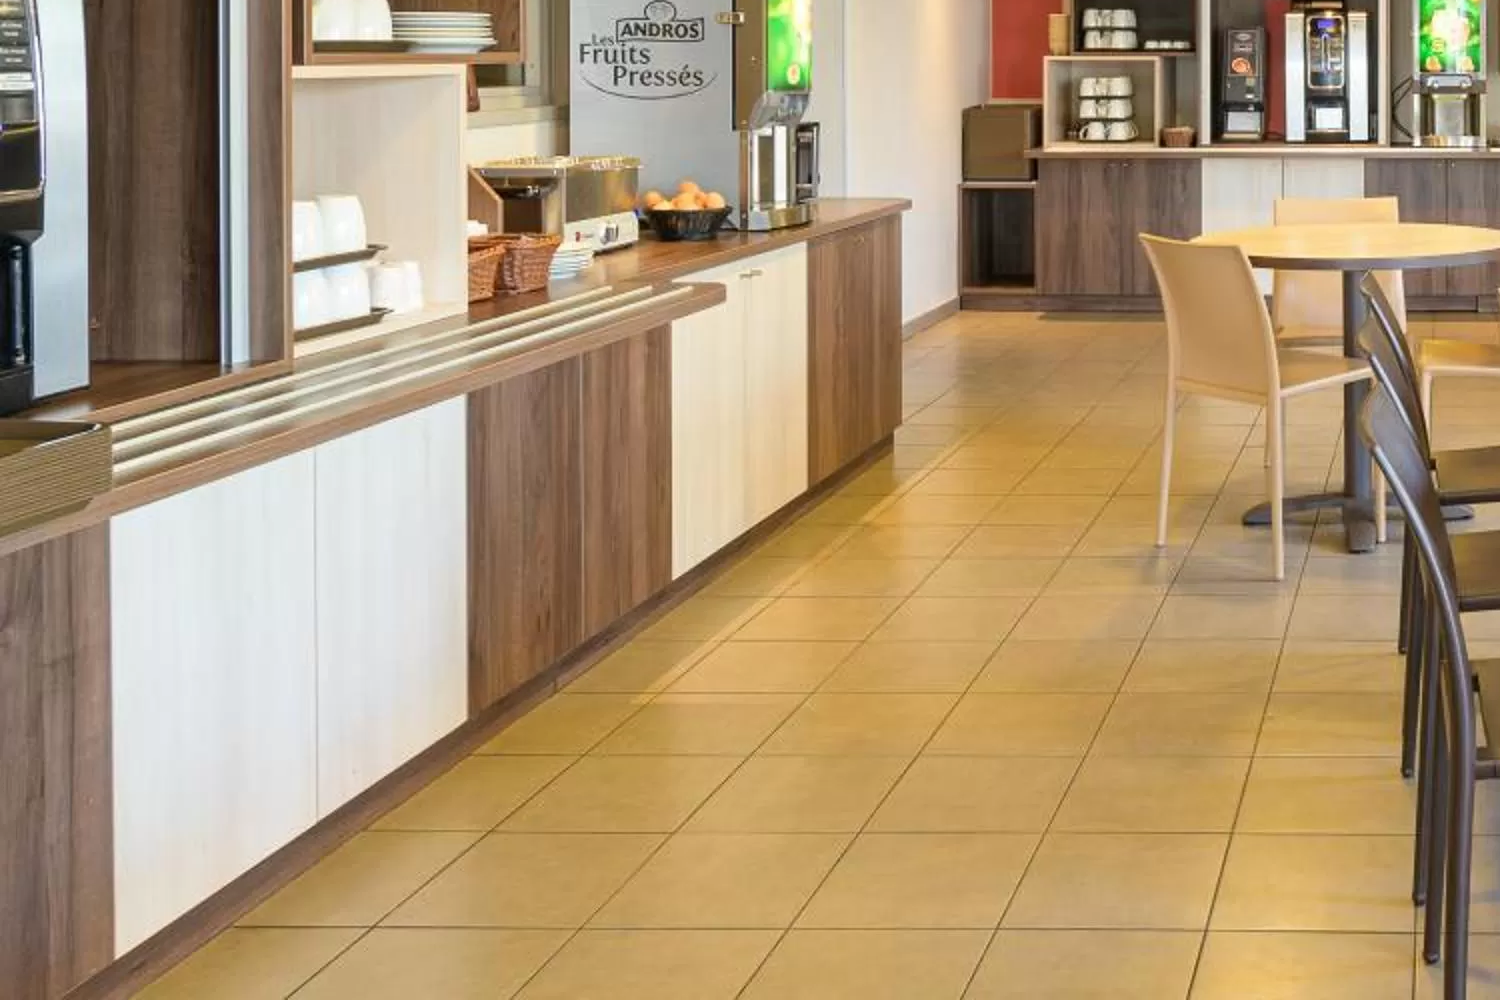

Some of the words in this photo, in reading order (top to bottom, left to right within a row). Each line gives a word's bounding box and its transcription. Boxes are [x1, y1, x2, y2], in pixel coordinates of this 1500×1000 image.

[620, 22, 699, 38] ANDROS
[591, 33, 615, 46] Les
[579, 43, 651, 64] Fruits
[613, 64, 704, 87] Pressés
